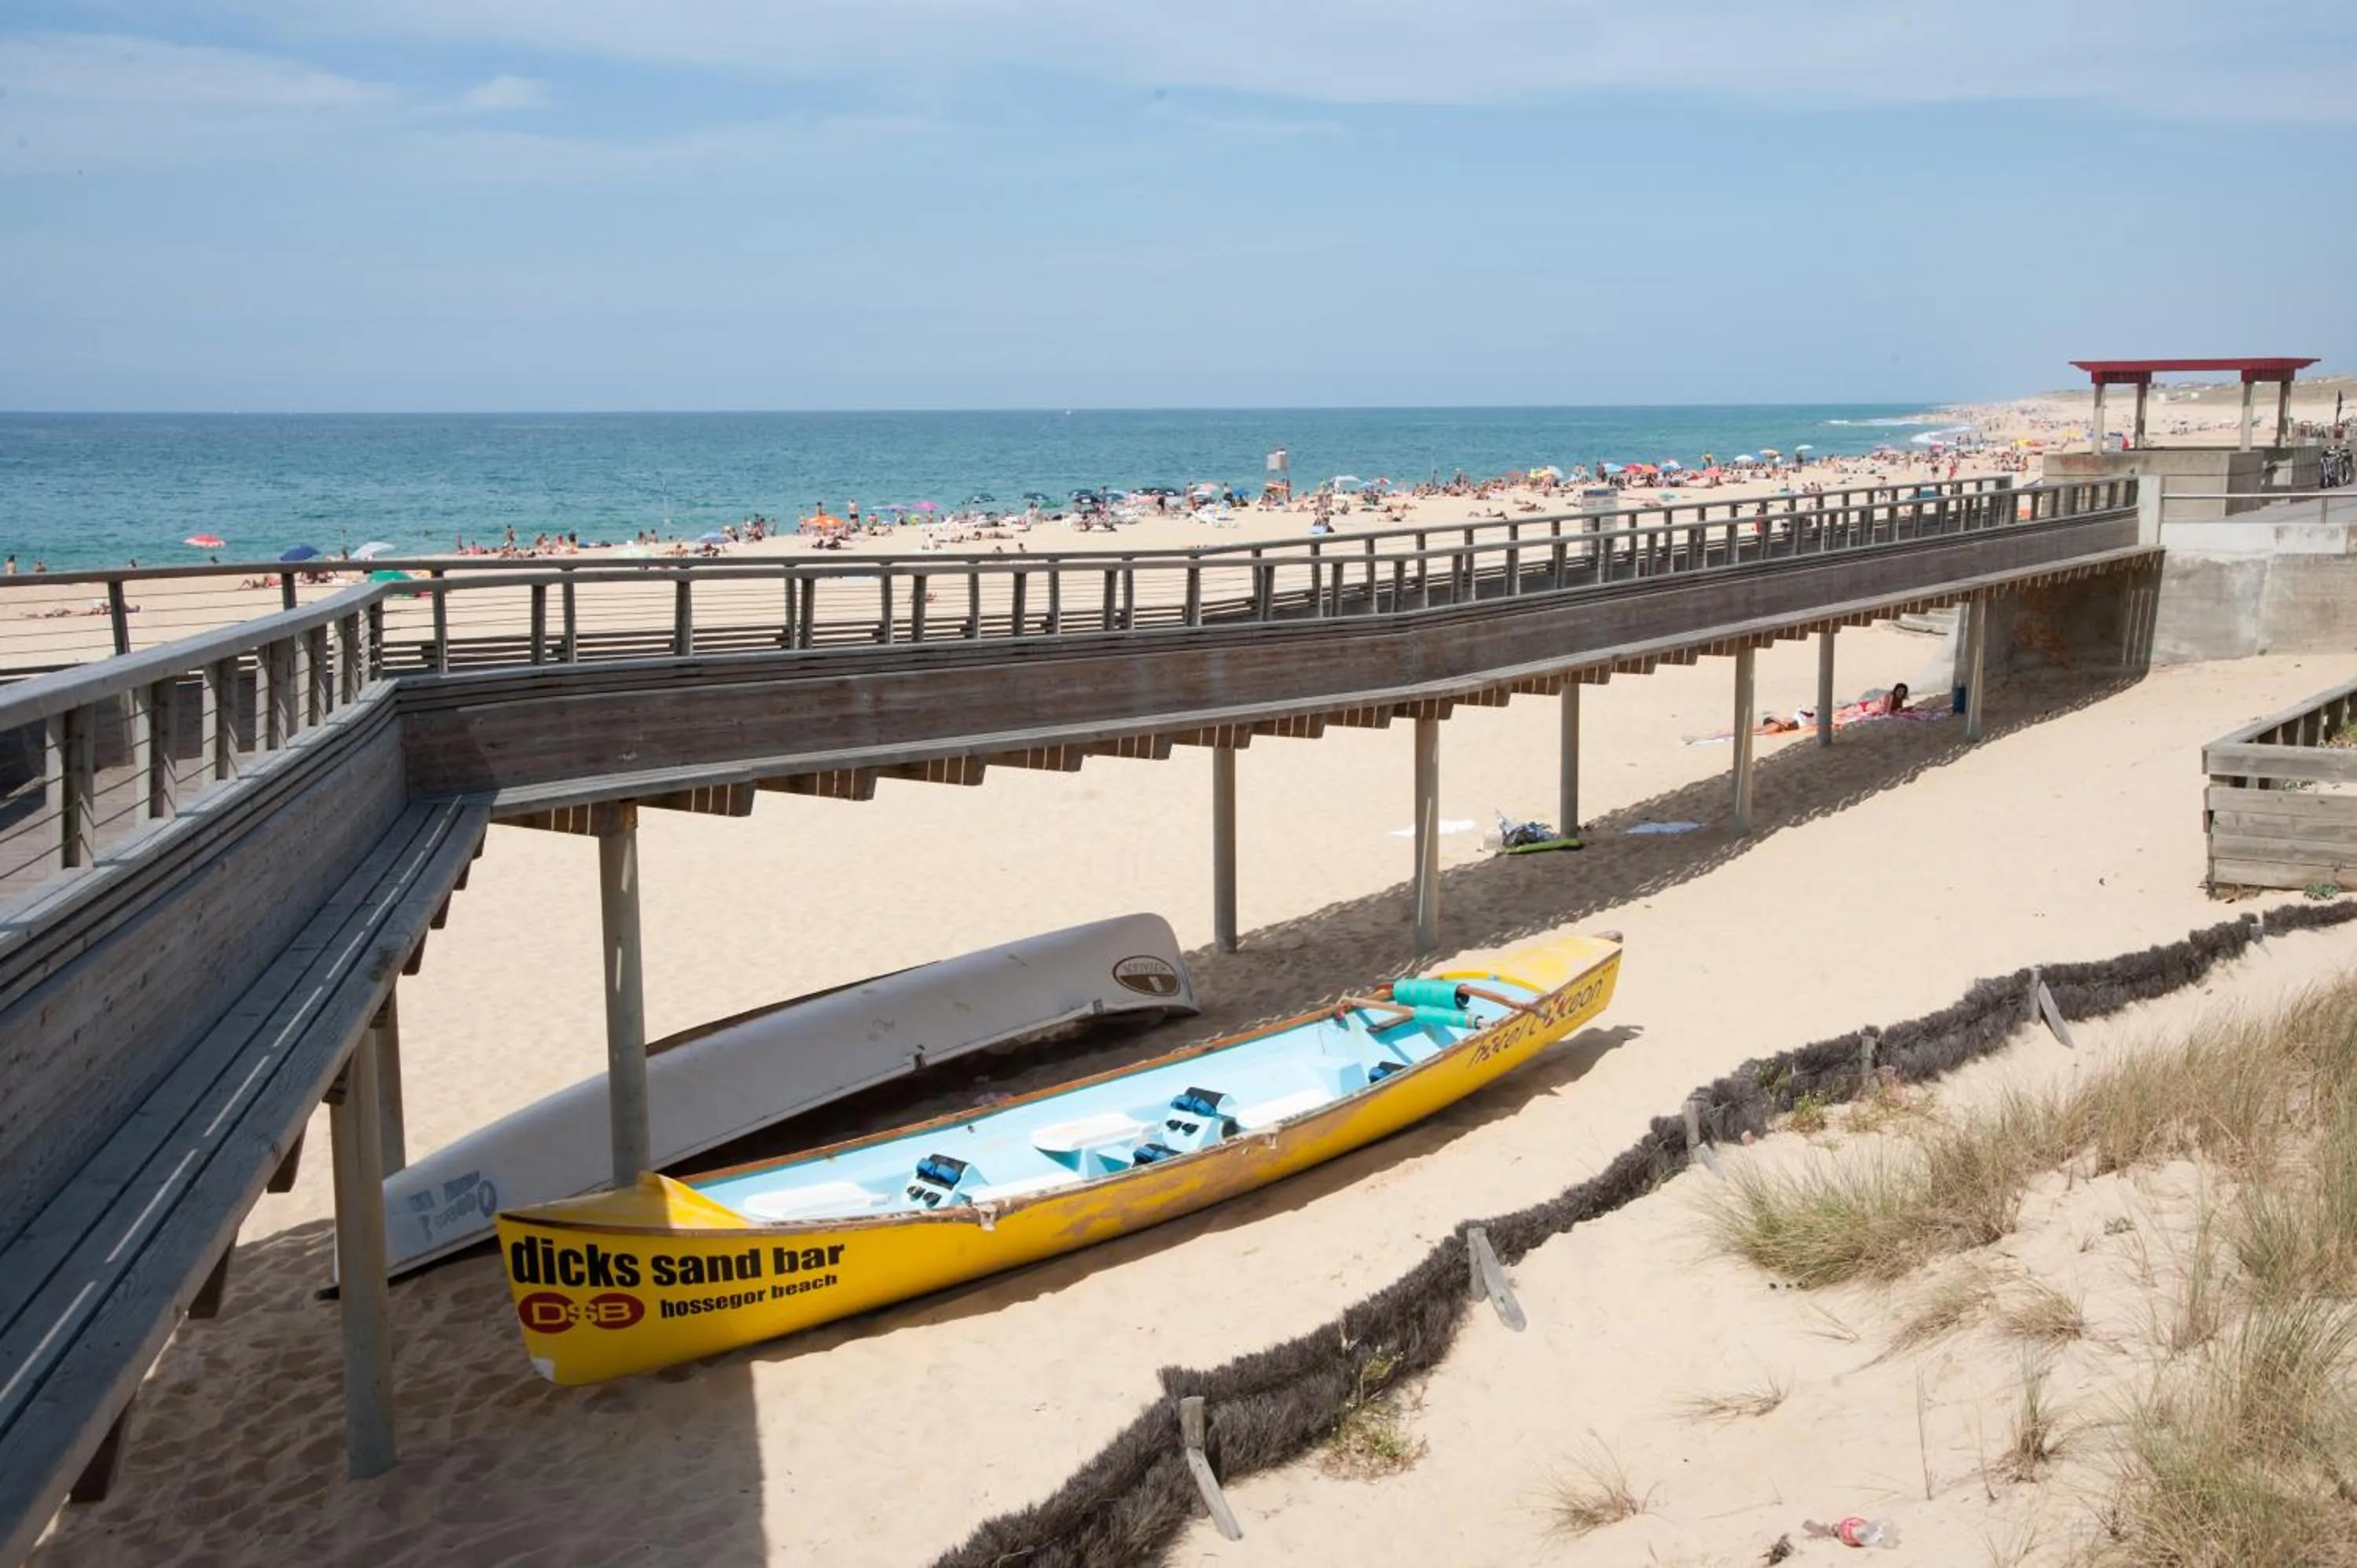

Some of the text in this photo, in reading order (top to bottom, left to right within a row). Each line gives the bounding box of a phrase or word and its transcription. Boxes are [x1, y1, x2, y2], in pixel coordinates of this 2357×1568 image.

[511, 1234, 845, 1287] dicks sand bar
[660, 1274, 838, 1319] hossegor beach
